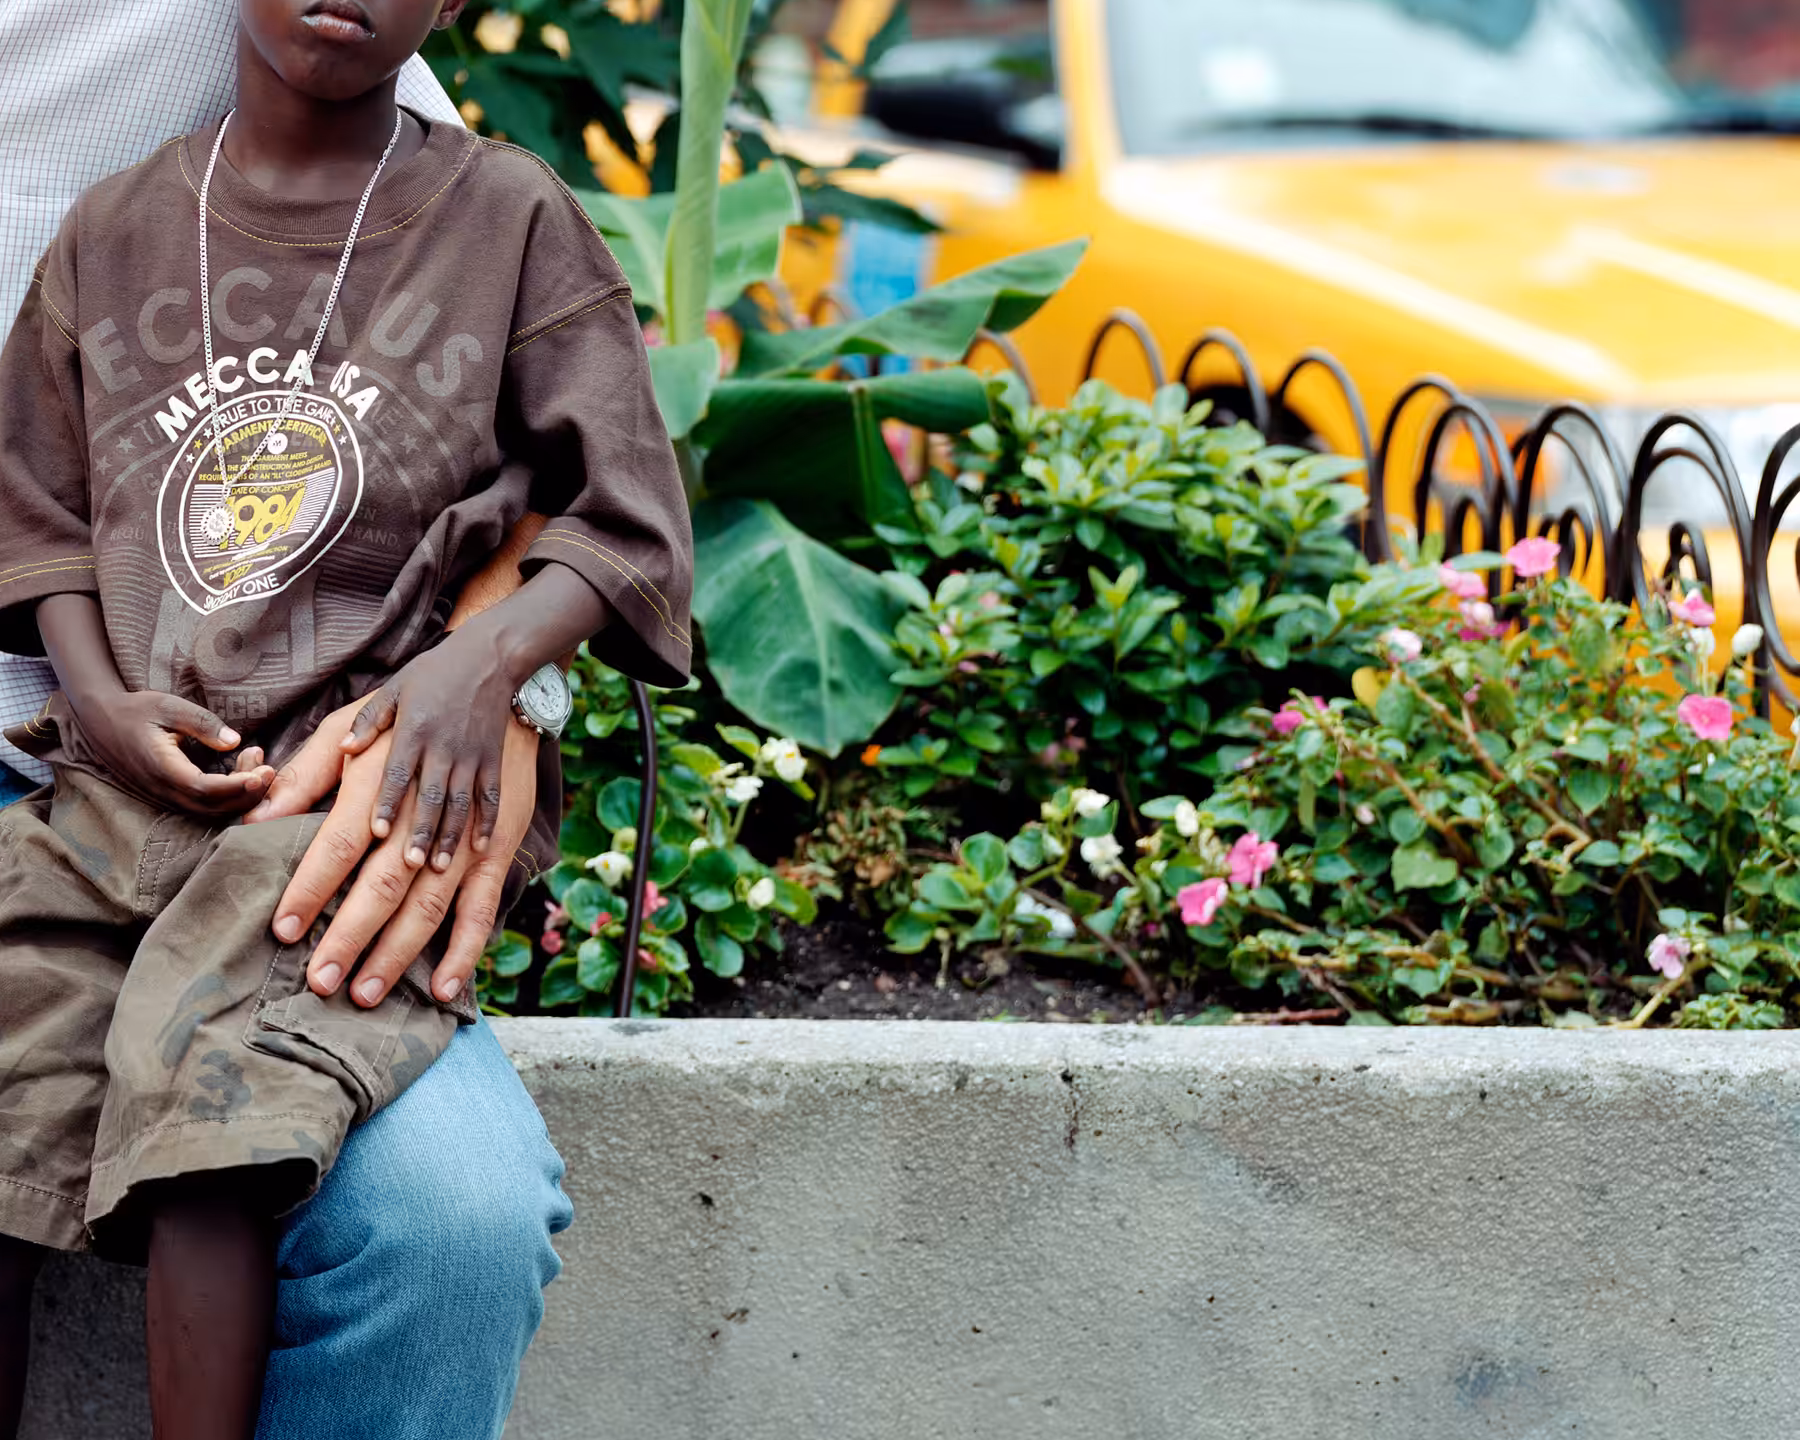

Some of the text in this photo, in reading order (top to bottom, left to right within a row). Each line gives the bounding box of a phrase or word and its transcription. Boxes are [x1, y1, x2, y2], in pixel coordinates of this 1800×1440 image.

[79, 266, 349, 395] ECCA
[154, 347, 315, 443] MECCA
[329, 361, 380, 421] USA
[211, 403, 248, 428] RUE
[249, 398, 272, 414] TO
[231, 486, 248, 496] DATE
[248, 485, 258, 494] OF
[242, 572, 280, 596] ONE
